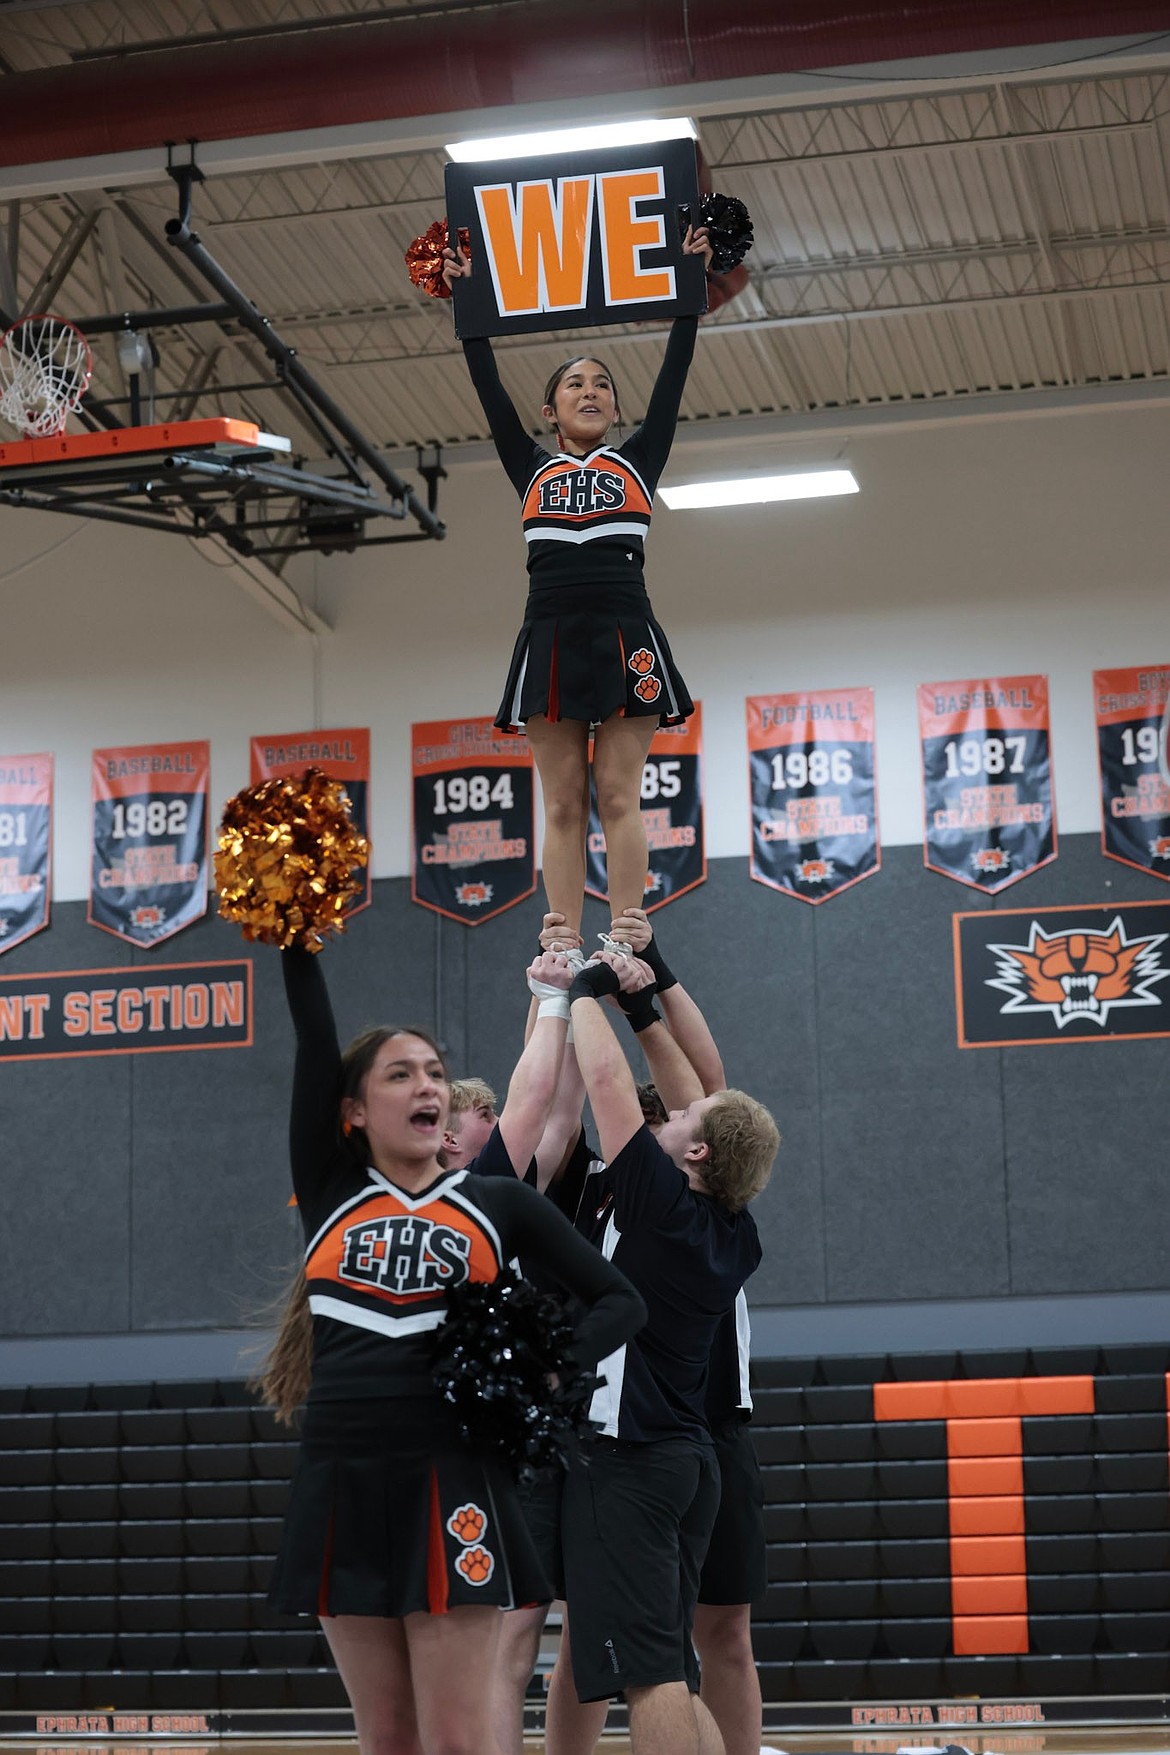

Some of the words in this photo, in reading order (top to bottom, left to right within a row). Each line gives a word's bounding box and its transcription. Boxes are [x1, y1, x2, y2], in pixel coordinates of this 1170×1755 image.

[473, 166, 677, 317] WE
[538, 468, 626, 516] EHS
[1138, 671, 1170, 692] BOY
[762, 702, 859, 729] FOOTBALL
[934, 687, 1033, 716] BASEBALL
[264, 740, 356, 768] BASEBALL
[945, 736, 1027, 778] 1987
[1120, 727, 1164, 765] 19
[106, 753, 196, 780] BASEBALL
[640, 761, 681, 799] 85
[771, 749, 853, 790] 1986
[433, 773, 514, 815] 1984
[786, 797, 841, 818] STATE
[112, 800, 188, 839] 1982
[760, 815, 868, 841] CHAMPIONS
[934, 803, 1043, 829] CHAMPIONS
[421, 838, 527, 865] CHAMPIONS
[99, 862, 198, 888] CHAMPIONS
[63, 981, 244, 1037] SECTION
[338, 1215, 472, 1295] EHS
[36, 1715, 109, 1733] EPHRATA
[113, 1715, 148, 1733] HIGH
[151, 1714, 209, 1733] SCHOOL
[852, 1706, 934, 1725] EPHRATA
[937, 1705, 978, 1723] HIGH
[981, 1703, 1046, 1722] SCHOOL
